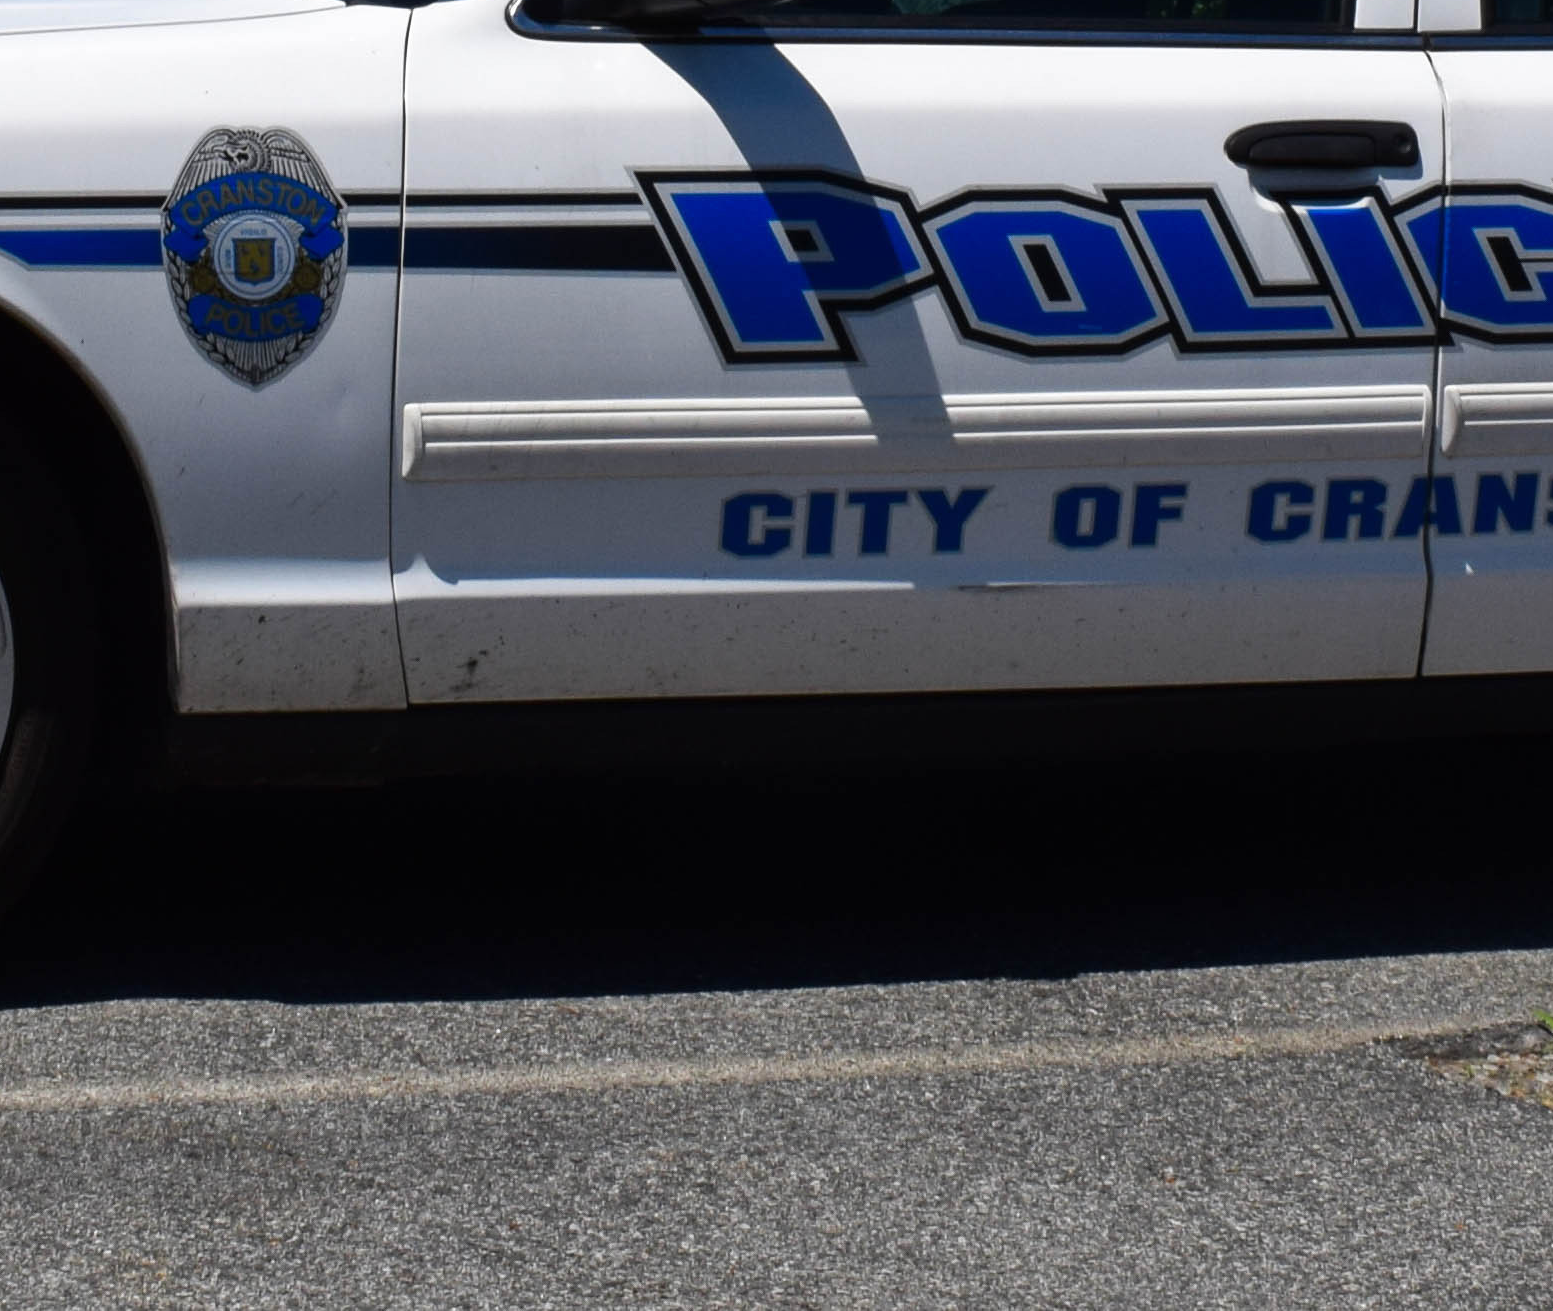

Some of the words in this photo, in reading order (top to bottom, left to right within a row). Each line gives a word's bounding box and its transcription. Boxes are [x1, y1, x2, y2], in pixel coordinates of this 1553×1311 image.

[181, 178, 326, 227] CRANSTON
[206, 303, 305, 338] POLICE
[719, 486, 994, 558] CITY
[1052, 483, 1189, 550] OF
